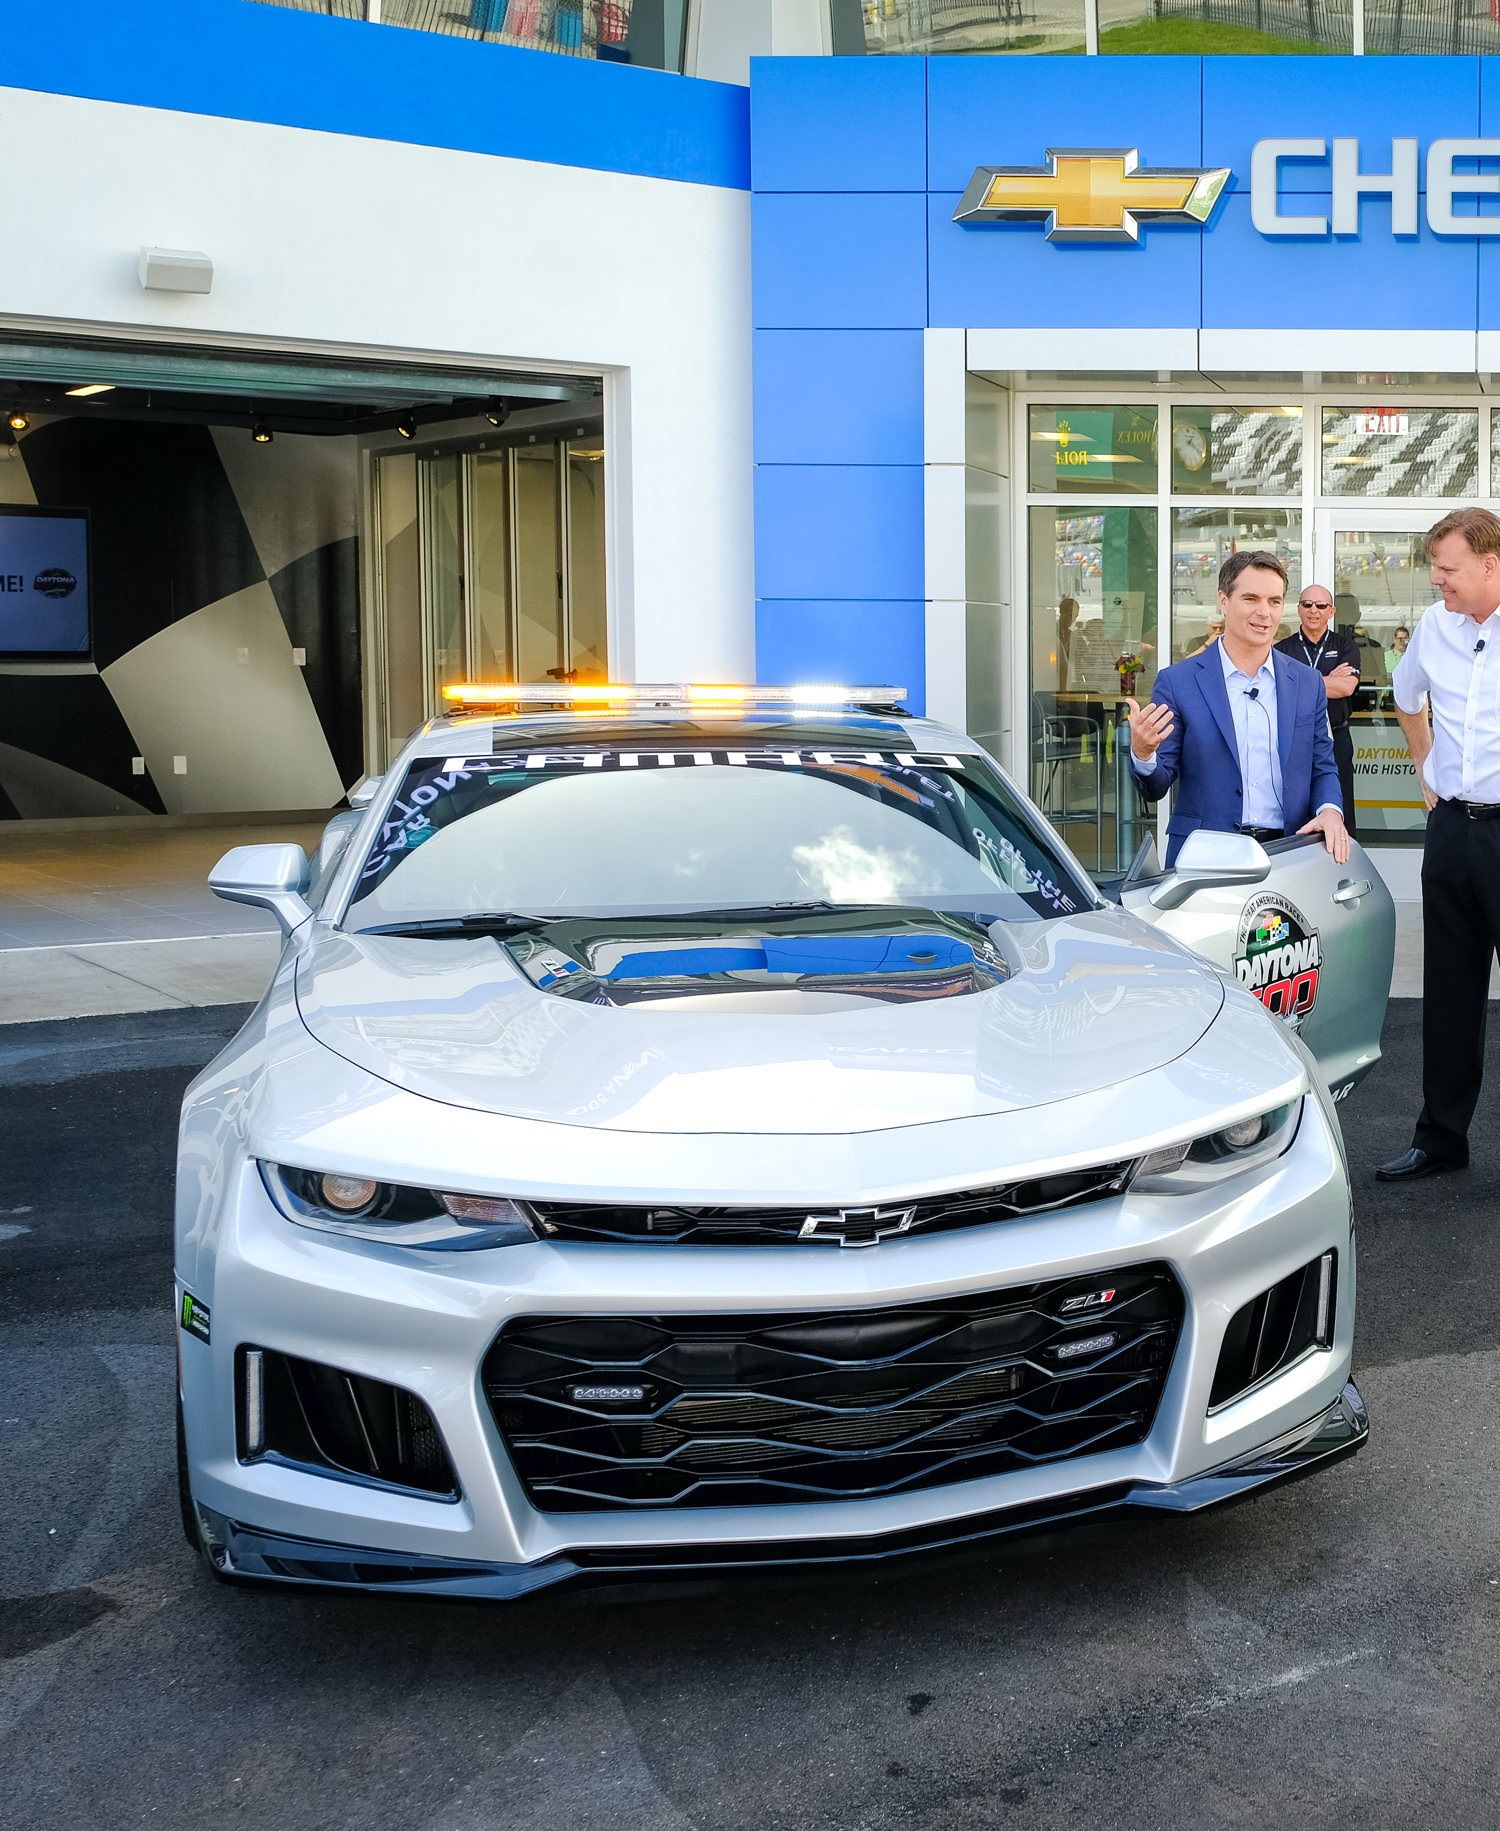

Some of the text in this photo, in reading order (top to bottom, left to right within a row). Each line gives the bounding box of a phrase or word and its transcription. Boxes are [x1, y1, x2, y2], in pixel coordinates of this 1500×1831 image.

[440, 751, 966, 773] CAMARO
[1357, 748, 1412, 760] DAYTONA
[1255, 895, 1285, 909] AMERICAN
[1236, 936, 1320, 989] DAYTONA
[1061, 1289, 1116, 1312] ZL1
